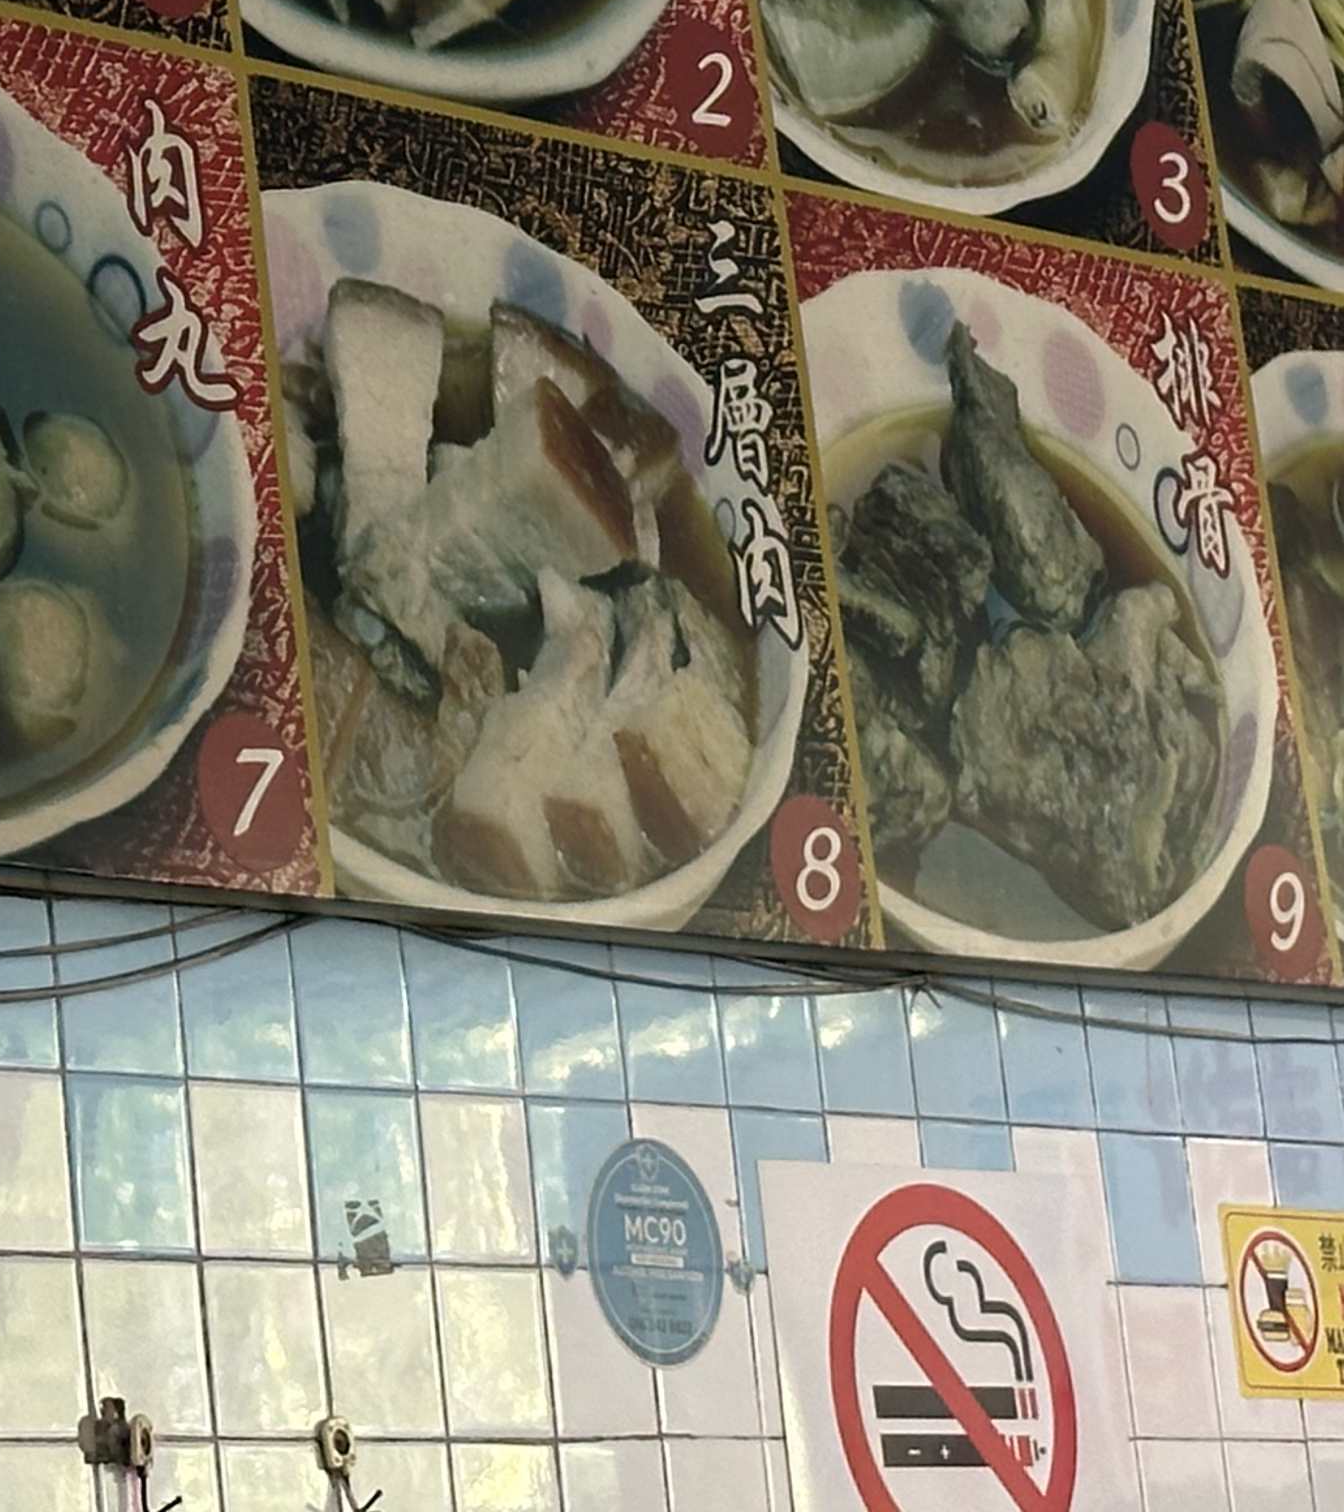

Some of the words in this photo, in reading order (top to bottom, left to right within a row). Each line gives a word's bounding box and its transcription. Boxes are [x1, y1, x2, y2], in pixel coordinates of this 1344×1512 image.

[690, 50, 734, 128] 2
[1153, 151, 1191, 224] 3
[125, 99, 240, 409] 肉丸
[697, 220, 802, 649] 三層肉
[1151, 310, 1233, 578] 排骨
[234, 747, 285, 836] 7
[795, 826, 842, 912] 8
[1269, 871, 1306, 953] 9
[623, 1214, 687, 1246] MC90
